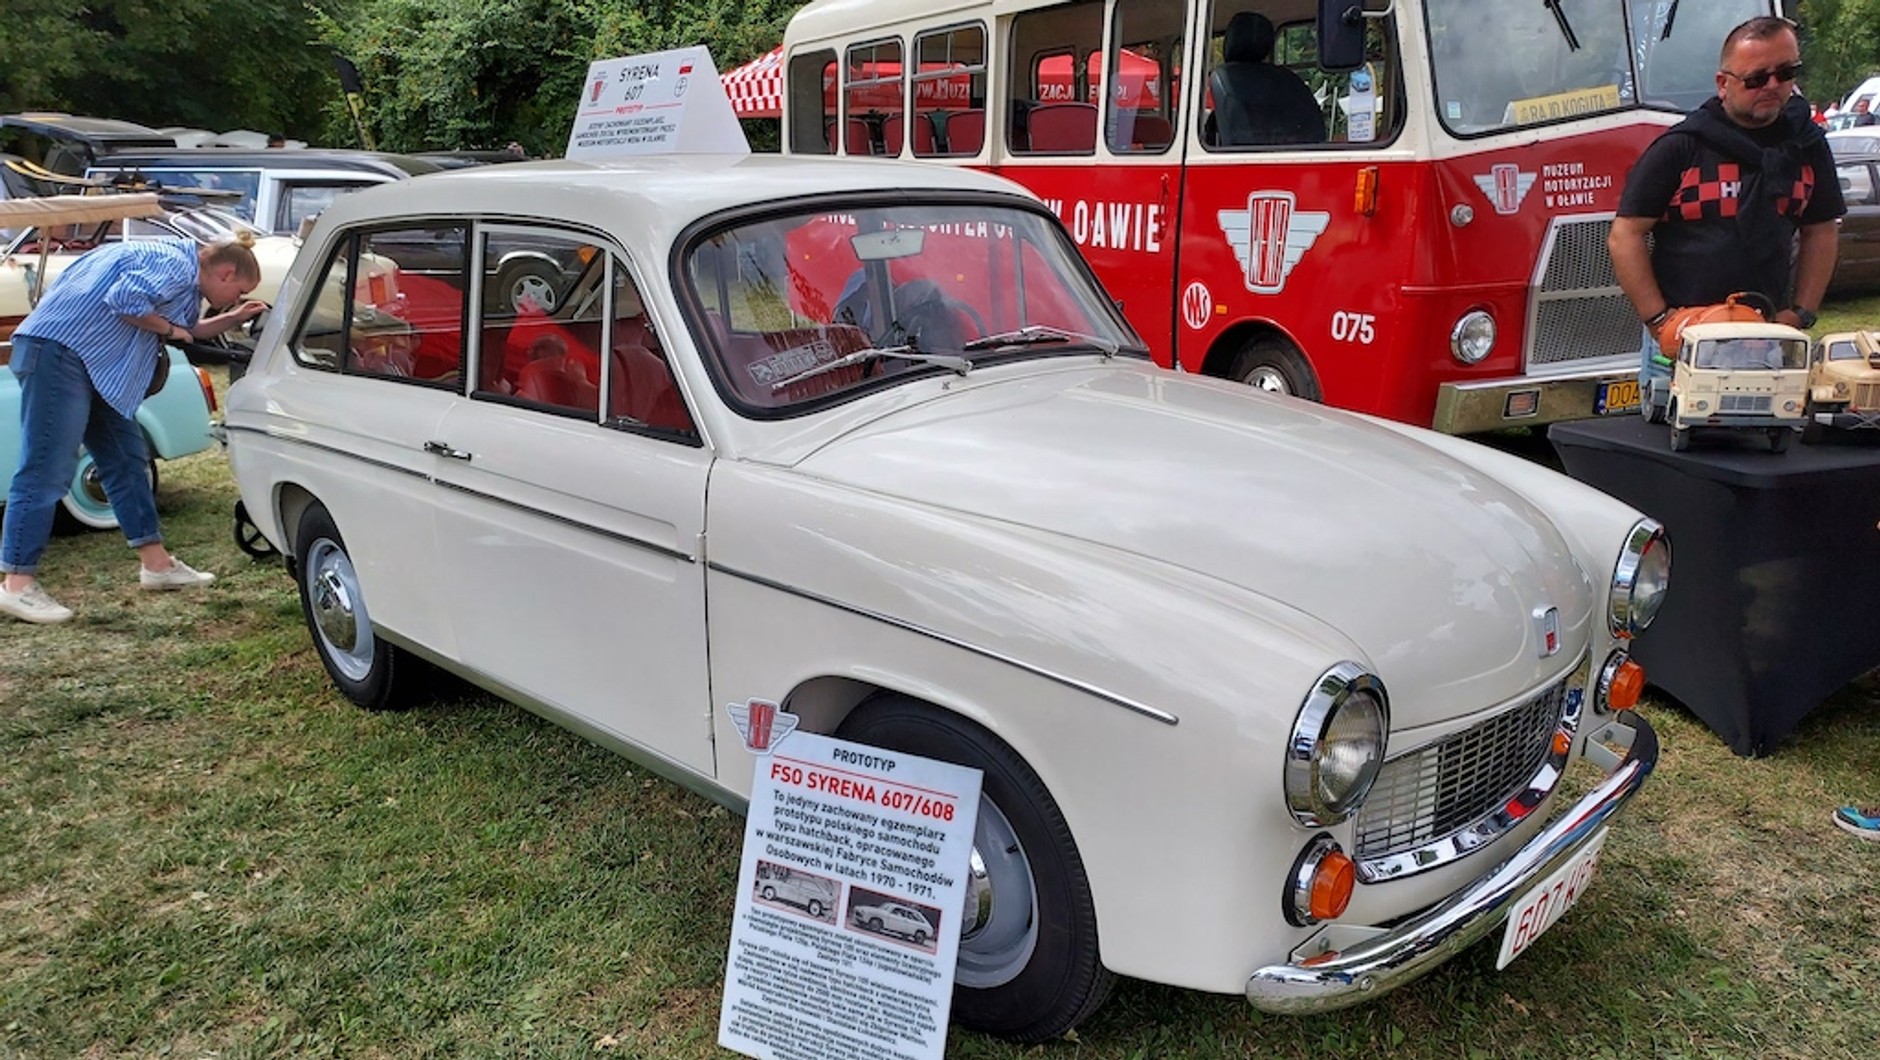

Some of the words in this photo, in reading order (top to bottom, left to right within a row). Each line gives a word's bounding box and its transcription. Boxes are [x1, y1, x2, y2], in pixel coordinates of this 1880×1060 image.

[619, 63, 659, 82] SYRENA
[624, 84, 644, 101] 607
[1543, 162, 1584, 177] MUZEUM
[1544, 176, 1612, 192] MOTORYZACJI
[1546, 195, 1554, 208] W
[1557, 192, 1594, 207] OŁAWIE
[1331, 310, 1375, 344] 075
[833, 748, 897, 772] PROTOTYP
[770, 763, 803, 785] FSO
[806, 771, 876, 802] SYRENA
[881, 789, 954, 821] 607/608
[773, 790, 785, 801] To
[785, 793, 819, 812] jedyny
[821, 804, 878, 826] zachowany
[880, 818, 945, 840] egzemplarz
[773, 806, 822, 825] prototypu
[823, 819, 875, 838] polskiego
[877, 832, 940, 853] samochodu
[755, 829, 764, 837] w
[765, 832, 834, 857] warszawskiej
[835, 848, 877, 866] Fabryce
[879, 859, 953, 886] Samochodów
[774, 819, 796, 832] typu
[798, 825, 852, 848] hatchback,
[855, 841, 935, 868] opracowanego
[765, 845, 822, 867] Osobowych
[823, 862, 832, 870] w
[834, 863, 867, 879] latach
[870, 872, 896, 886] 1970
[906, 882, 935, 897] 1971.
[1513, 881, 1564, 954] 607
